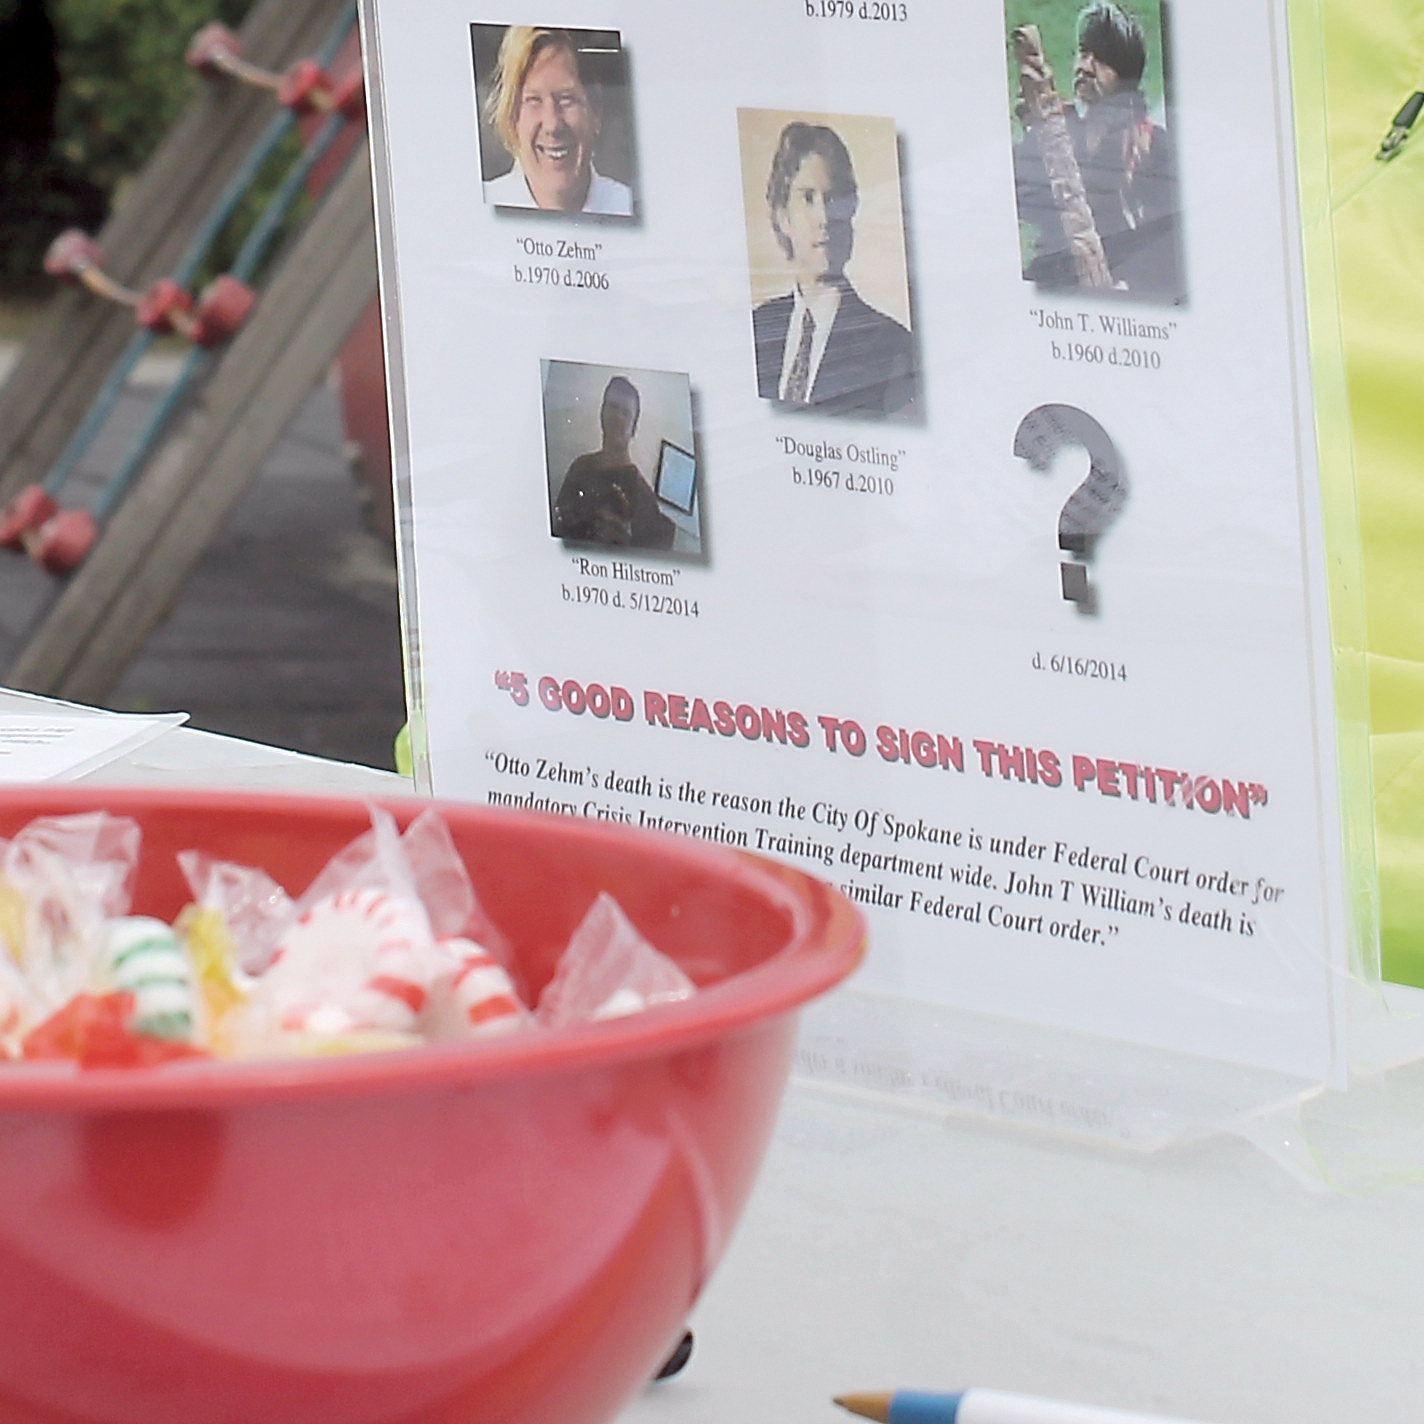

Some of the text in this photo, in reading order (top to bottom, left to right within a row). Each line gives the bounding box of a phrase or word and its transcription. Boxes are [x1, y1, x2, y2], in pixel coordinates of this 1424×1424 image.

[805, 0, 908, 22] b.1979 d.2013
[516, 238, 603, 260] “Otto Zehm”
[514, 265, 609, 290] b.1970 d.2006
[1029, 309, 1177, 340] “John T. Williams”
[1051, 341, 1161, 369] b.1960 d.2010
[775, 436, 906, 471] “Douglas Ostling”
[792, 466, 894, 495] b.1967 d.2010
[571, 557, 681, 586] “Ron Hilstrom”
[561, 584, 700, 618] b.1970 d. 5/12/2014
[1032, 652, 1128, 682] d. 6/16/2014
[538, 676, 634, 722] GOOD
[644, 690, 810, 748] REASONS
[818, 716, 867, 756] TO
[876, 724, 965, 772] SIGN
[973, 739, 1062, 787] THIS
[485, 751, 1285, 905] “Otto Zehm’s death is the reason the City Of Spokane is under Federal Court order for
[636, 809, 748, 847] Intervention
[755, 828, 834, 866] Training
[840, 843, 943, 881] department
[949, 864, 997, 891] wide.
[1004, 871, 1053, 899] John
[1061, 879, 1075, 902] T
[1080, 883, 1172, 921] William’s
[1178, 905, 1232, 933] death
[1238, 912, 1255, 937] is
[840, 879, 1120, 946] similar Federal Court order.”
